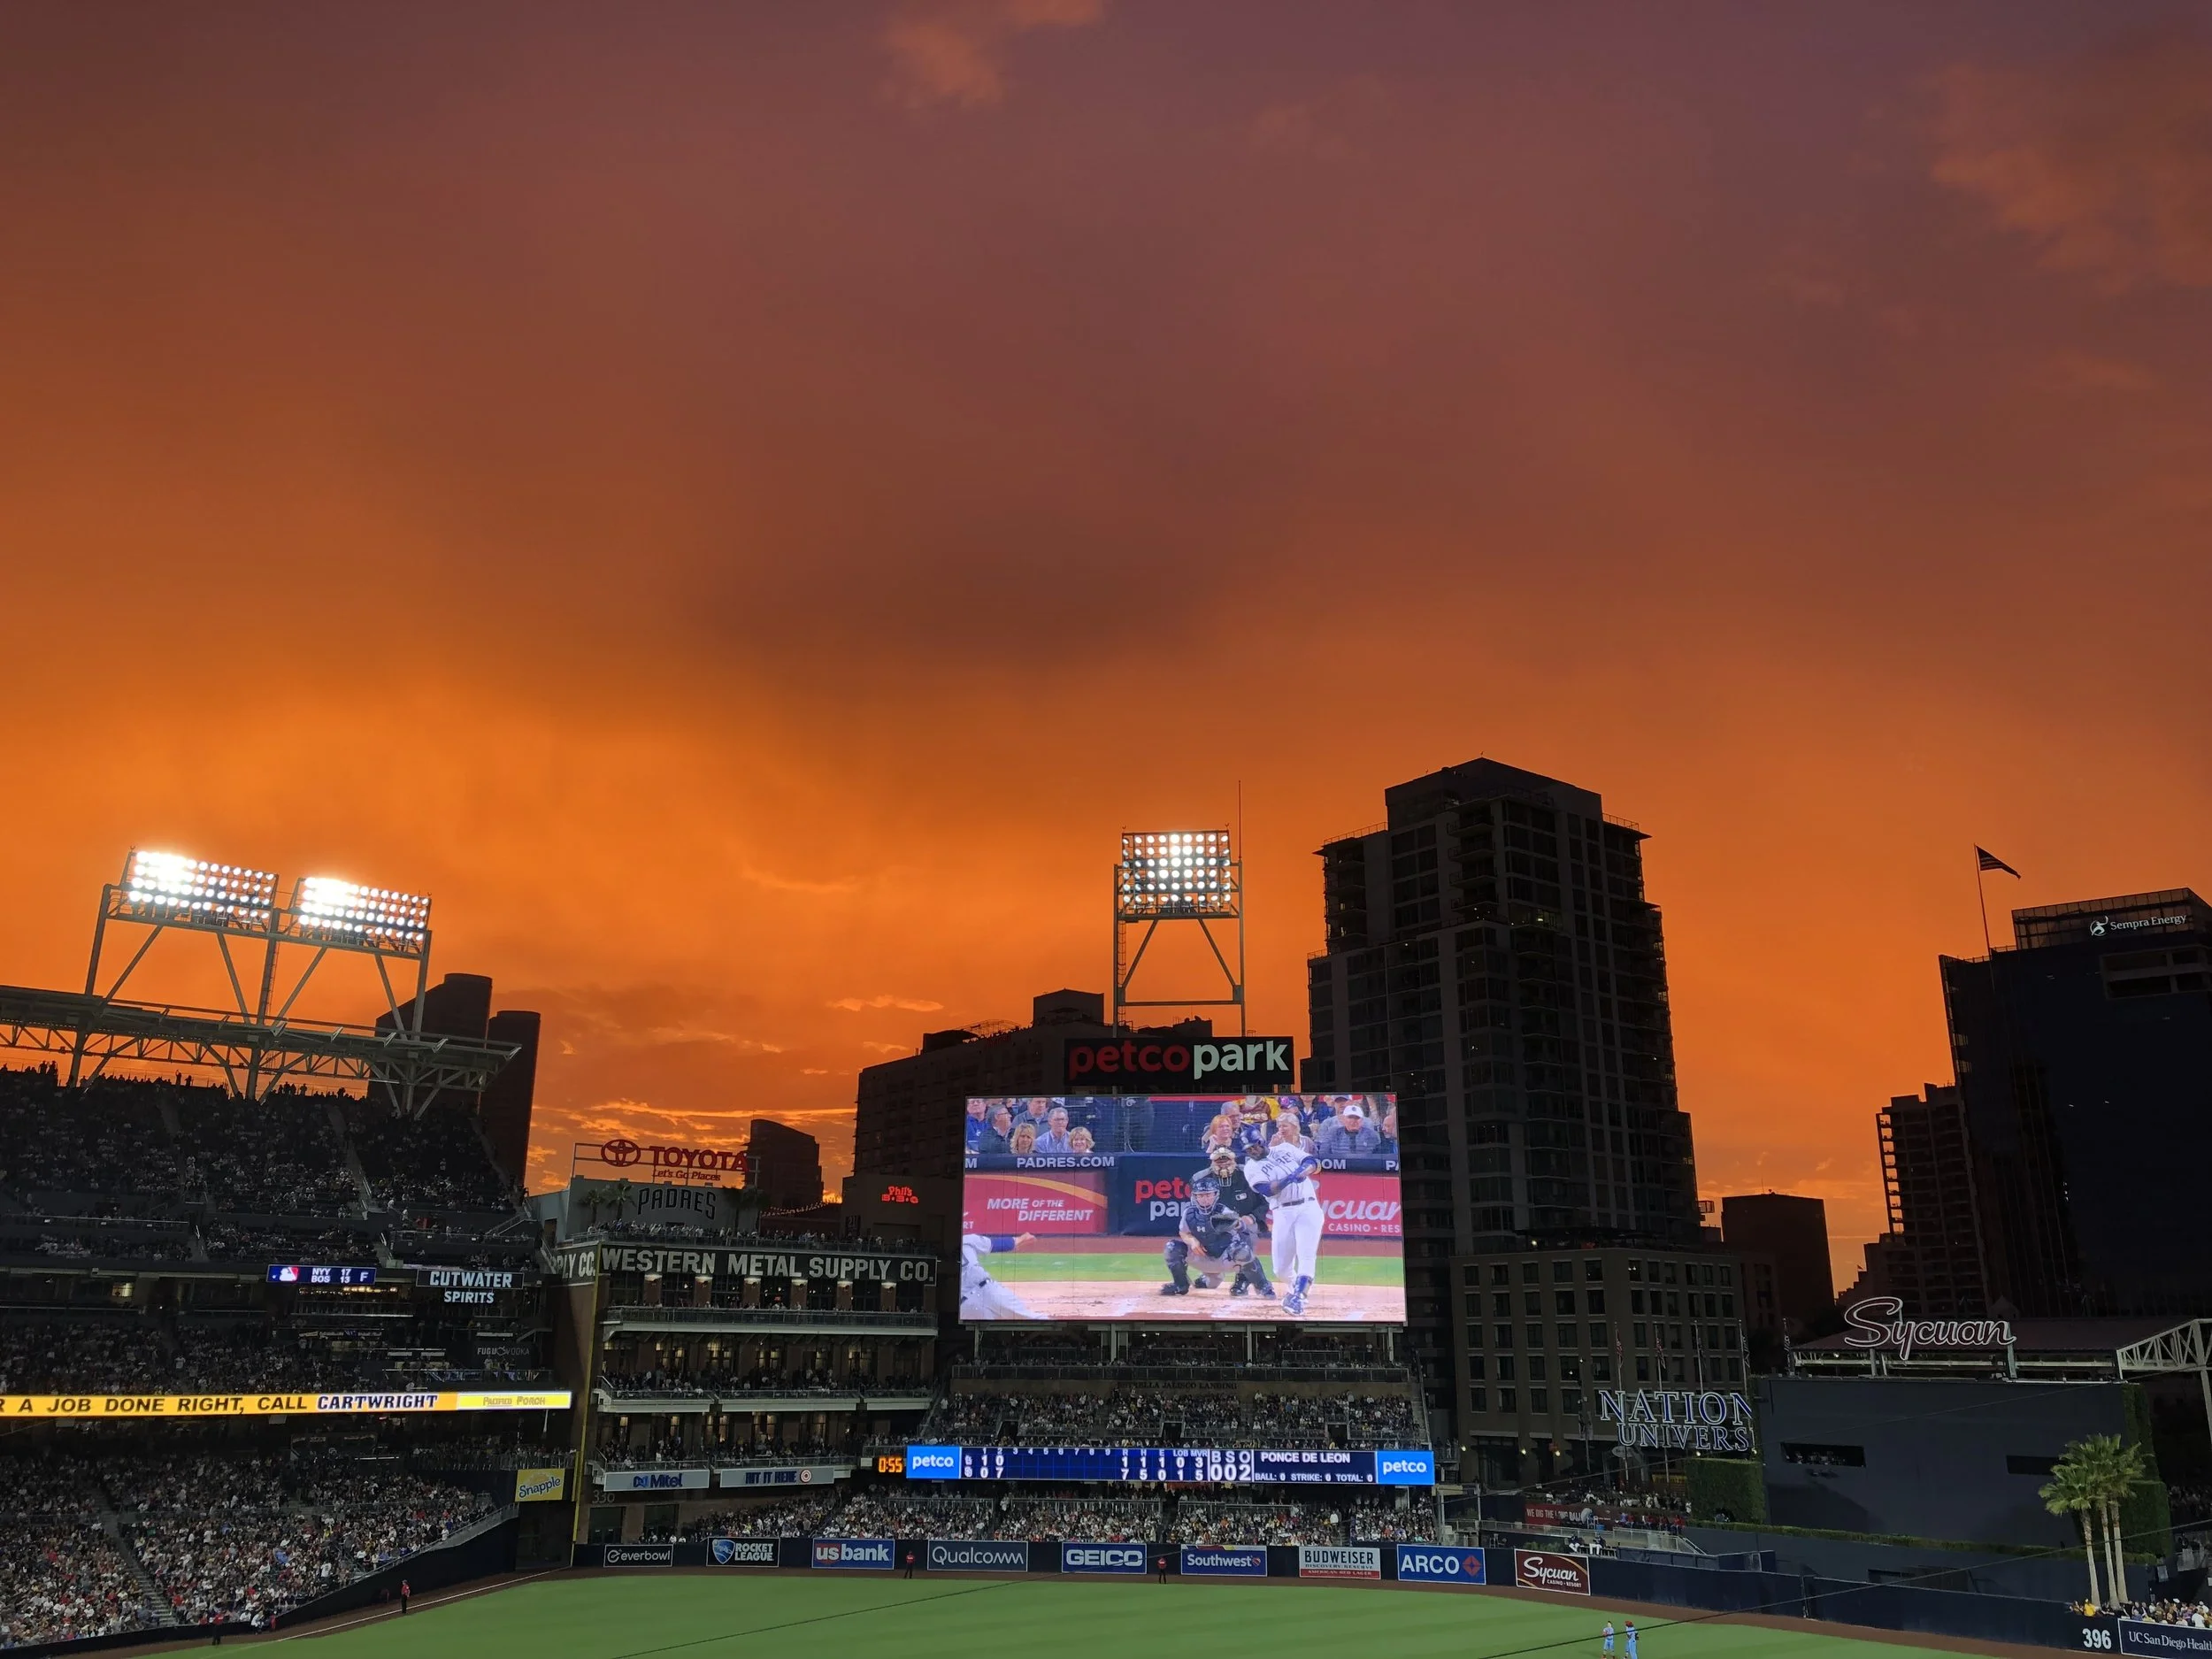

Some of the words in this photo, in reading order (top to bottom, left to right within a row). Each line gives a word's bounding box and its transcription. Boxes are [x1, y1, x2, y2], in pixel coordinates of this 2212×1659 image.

[2110, 919, 2149, 930] Sempra
[2151, 915, 2187, 926] Energy
[649, 1146, 749, 1171] TOYOTA
[1017, 1156, 1115, 1169] PADRES.COM
[652, 1169, 672, 1179] Let's
[692, 1171, 721, 1181] Places
[888, 1186, 913, 1196] Phil's
[637, 1187, 717, 1220] PADRES
[987, 1198, 1030, 1210] MORE
[1018, 1210, 1094, 1222] DIFFERENT
[1328, 1223, 1371, 1232] CASINO
[602, 1248, 716, 1274] WESTERN
[727, 1254, 802, 1278] METAL
[809, 1257, 892, 1280] SUPPLY
[900, 1261, 934, 1282] CO.
[359, 1272, 368, 1281] F
[430, 1271, 513, 1288] CUTWATER
[444, 1292, 495, 1304] SPIRITS
[1844, 1296, 2017, 1361] Sycuan
[478, 1347, 497, 1356] FUGU
[504, 1347, 530, 1356] VODKA
[18, 1398, 34, 1412] A
[47, 1398, 91, 1412] JOB
[104, 1398, 165, 1412] DONE
[177, 1397, 244, 1415] RIGHT,
[257, 1396, 308, 1410] CALL
[317, 1394, 438, 1409] CARTWRIGHT
[1598, 1388, 1753, 1425] NATION
[1616, 1423, 1749, 1452] UNIVERS
[912, 1455, 954, 1470] petco
[981, 1455, 987, 1465] 1
[995, 1455, 1004, 1466] 0
[1122, 1456, 1127, 1467] 1
[1140, 1456, 1147, 1467] 1
[1159, 1456, 1164, 1467] 1
[1176, 1457, 1185, 1468] 0
[1194, 1457, 1203, 1469] 3
[1211, 1451, 1221, 1463] B
[1225, 1451, 1235, 1463] S
[1239, 1451, 1251, 1463] O
[1261, 1452, 1300, 1463] PONCE
[1302, 1453, 1317, 1463] DE
[1320, 1453, 1350, 1463] LEON
[878, 1457, 903, 1472] 0:55
[1382, 1460, 1427, 1475] petco
[649, 1472, 683, 1488] Mitel
[745, 1471, 761, 1485] HIT
[763, 1471, 772, 1483] IT
[980, 1467, 989, 1478] 0
[995, 1467, 1003, 1479] 7
[1120, 1469, 1129, 1479] 7
[1140, 1469, 1148, 1480] 5
[1157, 1469, 1166, 1480] 0
[1178, 1470, 1184, 1480] 1
[1195, 1470, 1203, 1481] 5
[1255, 1472, 1277, 1481] BALL:
[518, 1476, 561, 1499] Snapple
[592, 1490, 616, 1504] 330
[1545, 1509, 1554, 1518] THE
[734, 1543, 774, 1553] ROCKET
[621, 1550, 671, 1561] everbowl
[734, 1552, 774, 1562] LEAGUE
[932, 1546, 1024, 1565] Qualcomm
[1066, 1549, 1143, 1566] GEICO
[1187, 1554, 1253, 1568] Southwest
[1304, 1550, 1373, 1564] BUDWEISER
[1401, 1554, 1460, 1575] ARCO
[1524, 1557, 1578, 1585] Sycuan
[2082, 1628, 2112, 1649] 396
[2128, 1632, 2143, 1644] UC
[2143, 1632, 2161, 1646] San
[2161, 1635, 2186, 1651] Diego
